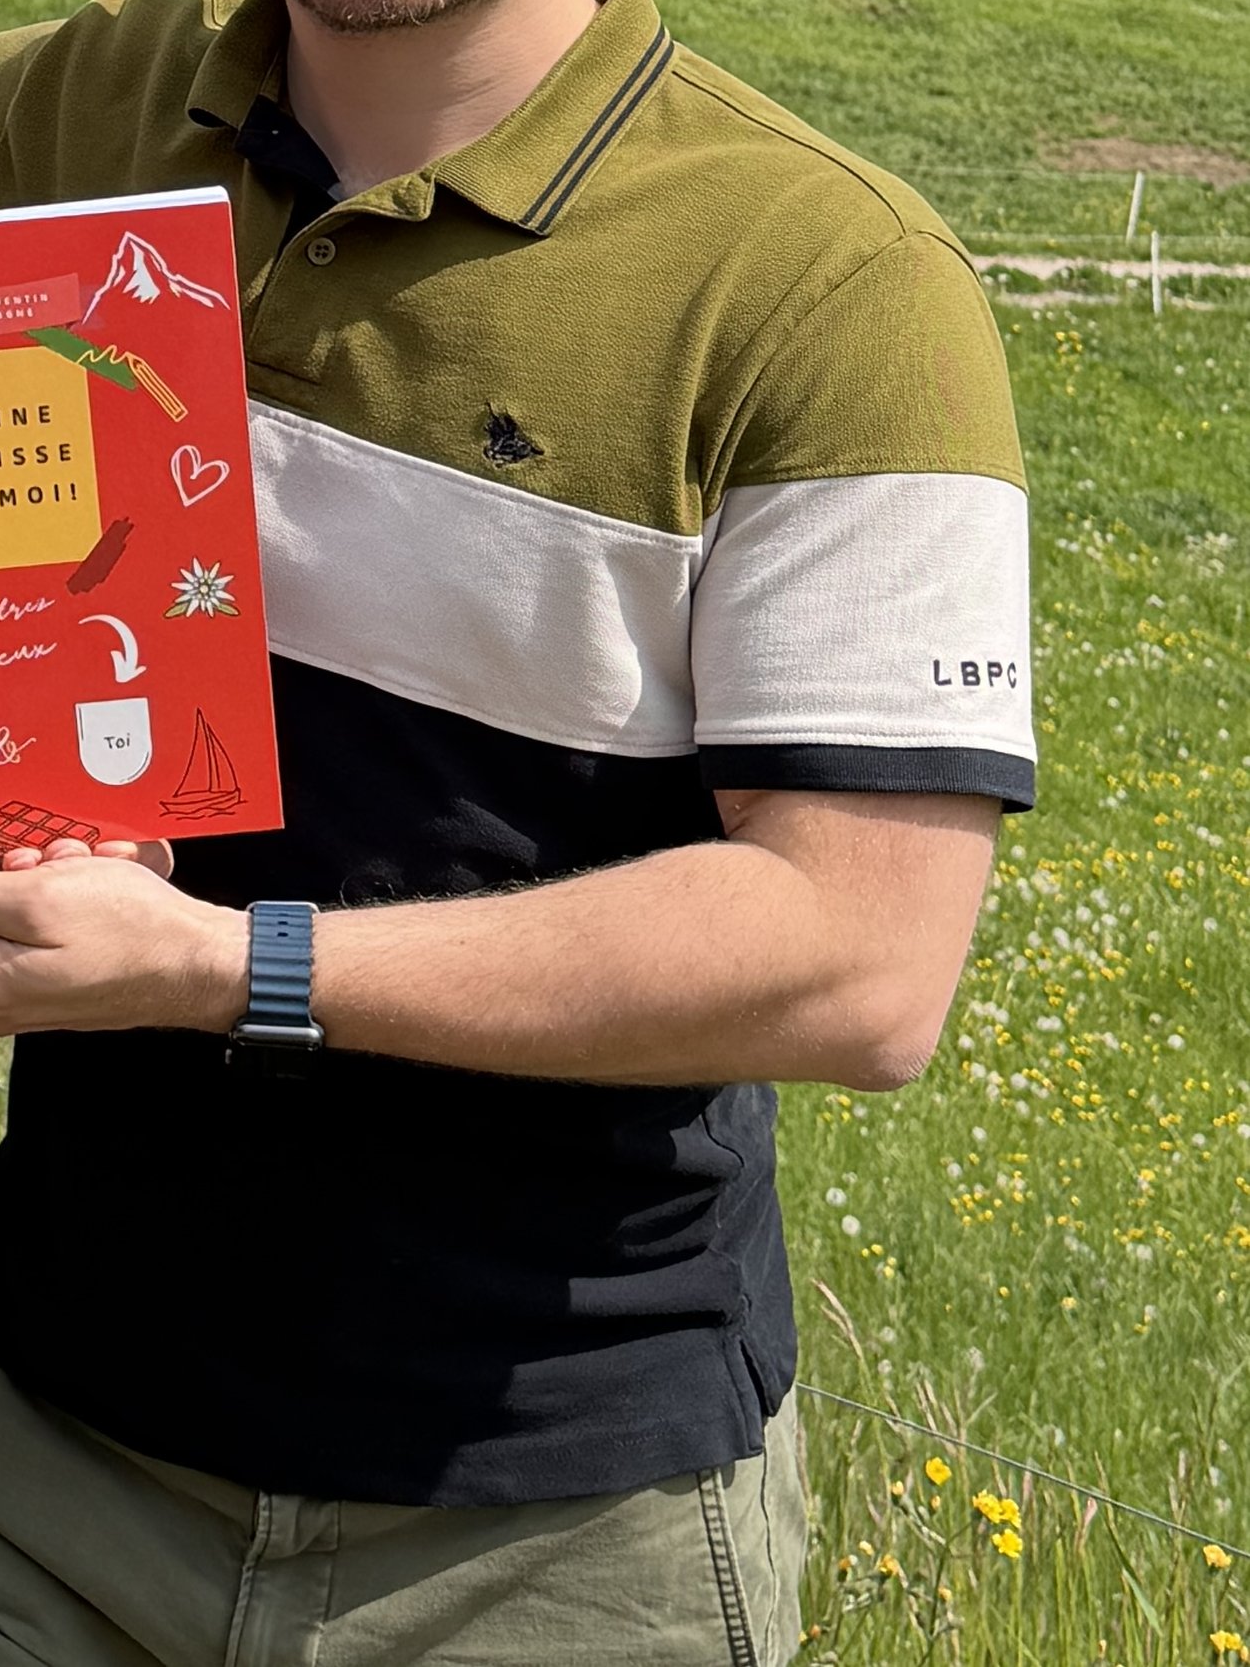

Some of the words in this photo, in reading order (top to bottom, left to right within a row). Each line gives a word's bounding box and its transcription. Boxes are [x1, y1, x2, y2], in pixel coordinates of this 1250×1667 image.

[0, 482, 78, 508] MOI!
[933, 659, 1017, 689] LBPC
[104, 732, 131, 750] Toi
